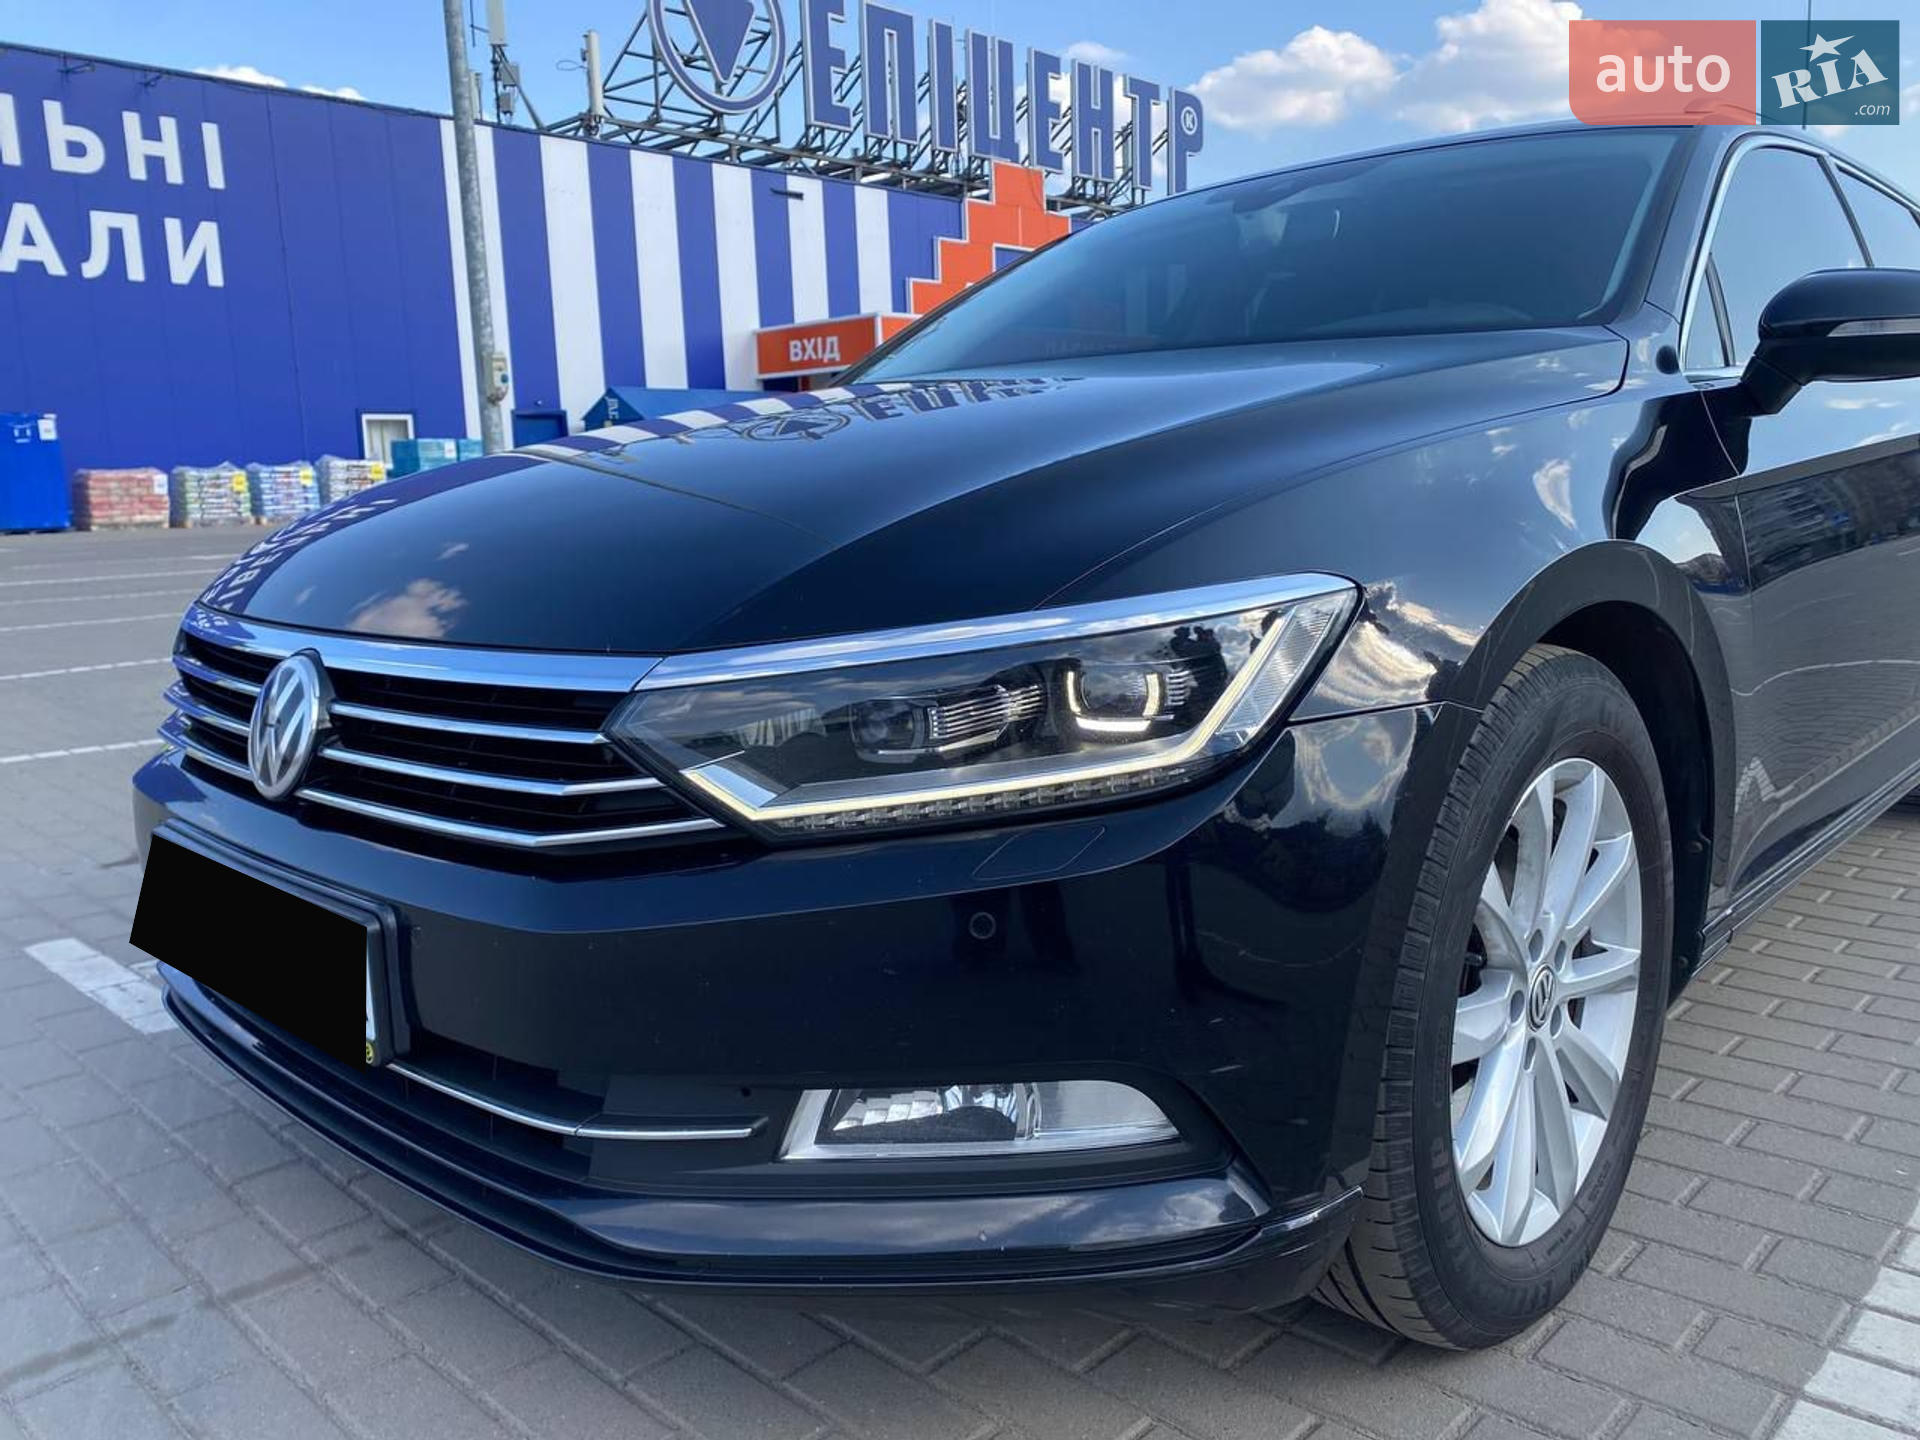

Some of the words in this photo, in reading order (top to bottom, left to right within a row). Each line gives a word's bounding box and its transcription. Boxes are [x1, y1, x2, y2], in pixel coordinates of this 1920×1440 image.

[801, 0, 1203, 195] ЕПІЦЕНТР
[0, 202, 224, 288] АЛИ
[789, 336, 841, 363] ВХІД
